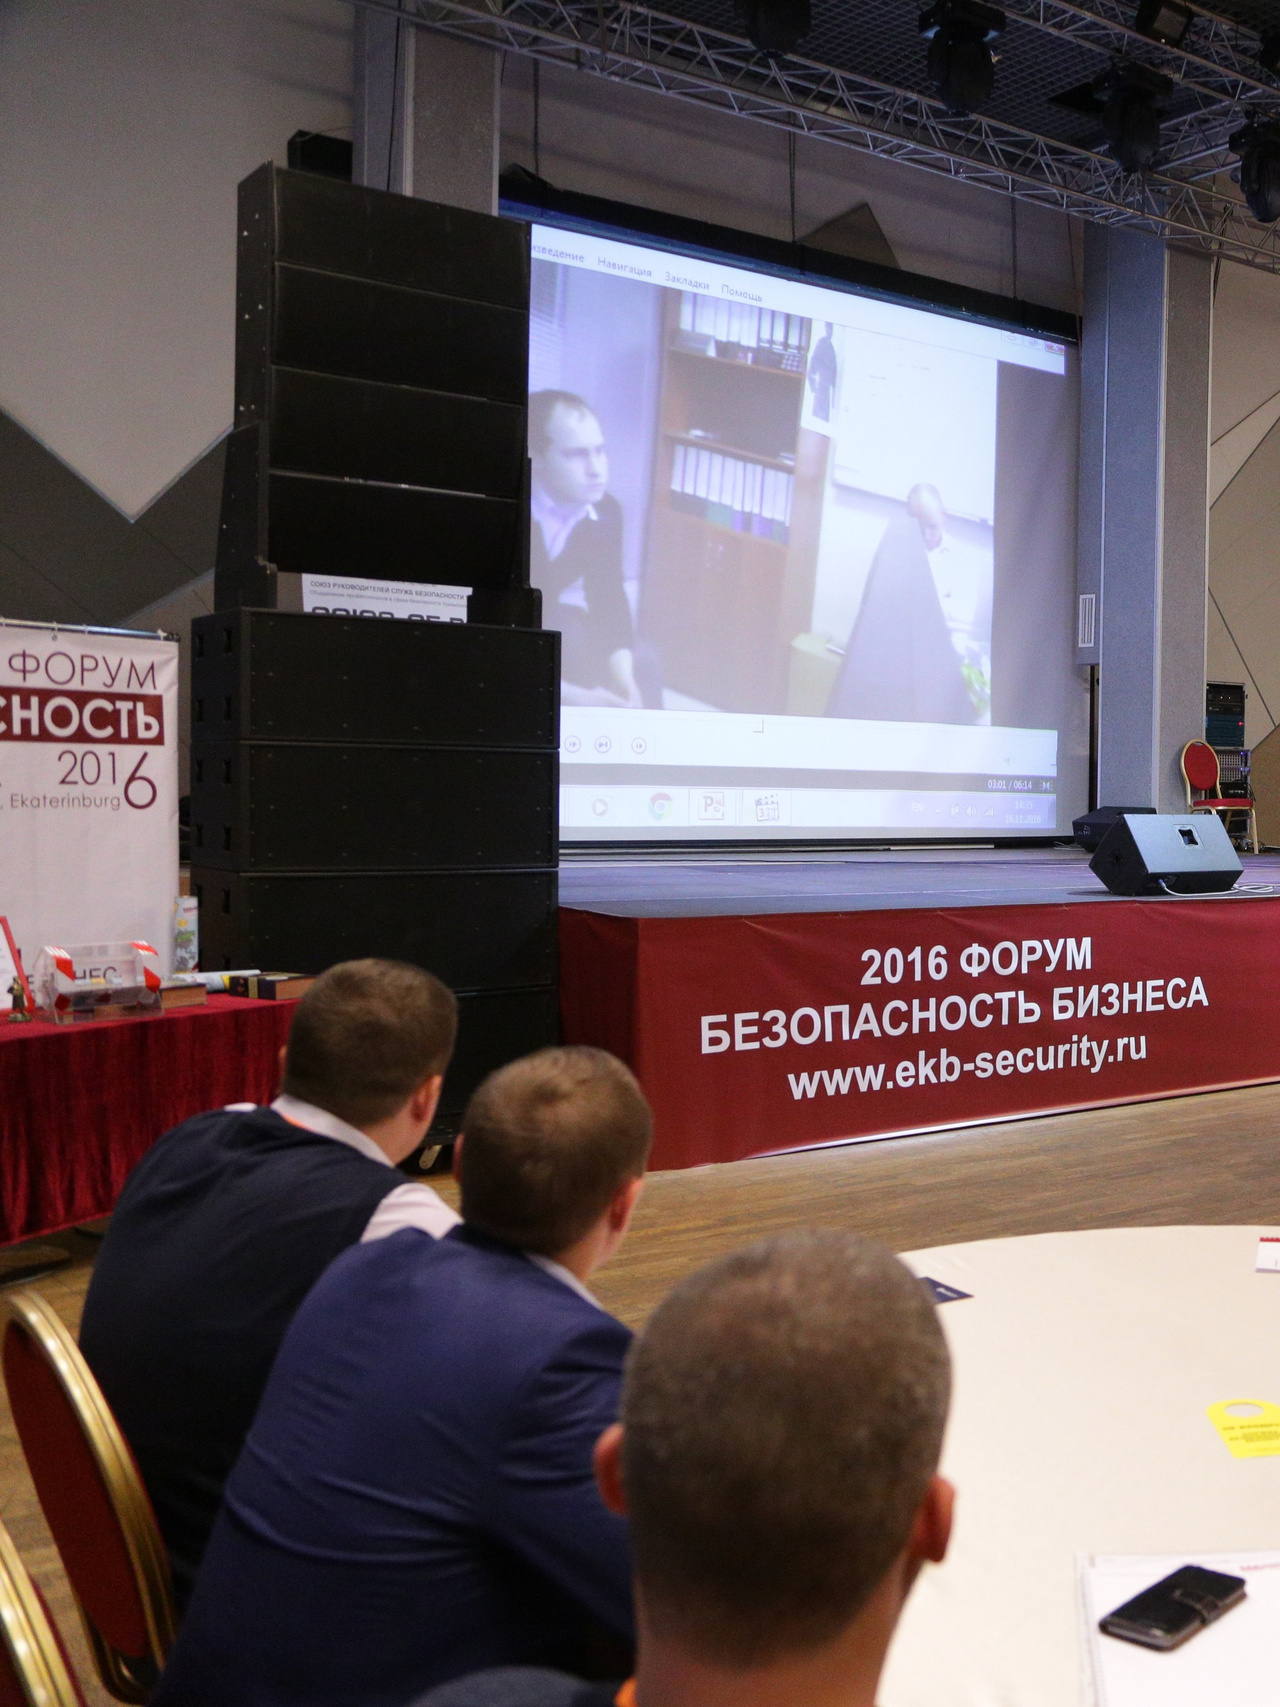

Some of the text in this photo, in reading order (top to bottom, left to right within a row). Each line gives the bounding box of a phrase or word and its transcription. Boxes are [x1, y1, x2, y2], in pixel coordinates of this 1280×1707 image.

[598, 257, 652, 278] Навигация
[665, 271, 710, 291] Закладки
[721, 284, 763, 302] Помощь
[310, 580, 331, 589] СОЮЗ
[8, 650, 157, 690] ФОРУМ
[0, 694, 160, 739] НОСТЬ
[10, 792, 121, 811] Ekaterinburg
[58, 750, 157, 810] 2016
[860, 936, 1093, 986] 2016 ФОРУМ
[701, 976, 1210, 1055] БЕЗОПАСНОСТЬ БИЗНЕСА
[787, 1035, 1148, 1100] www.ekb-security.ru
